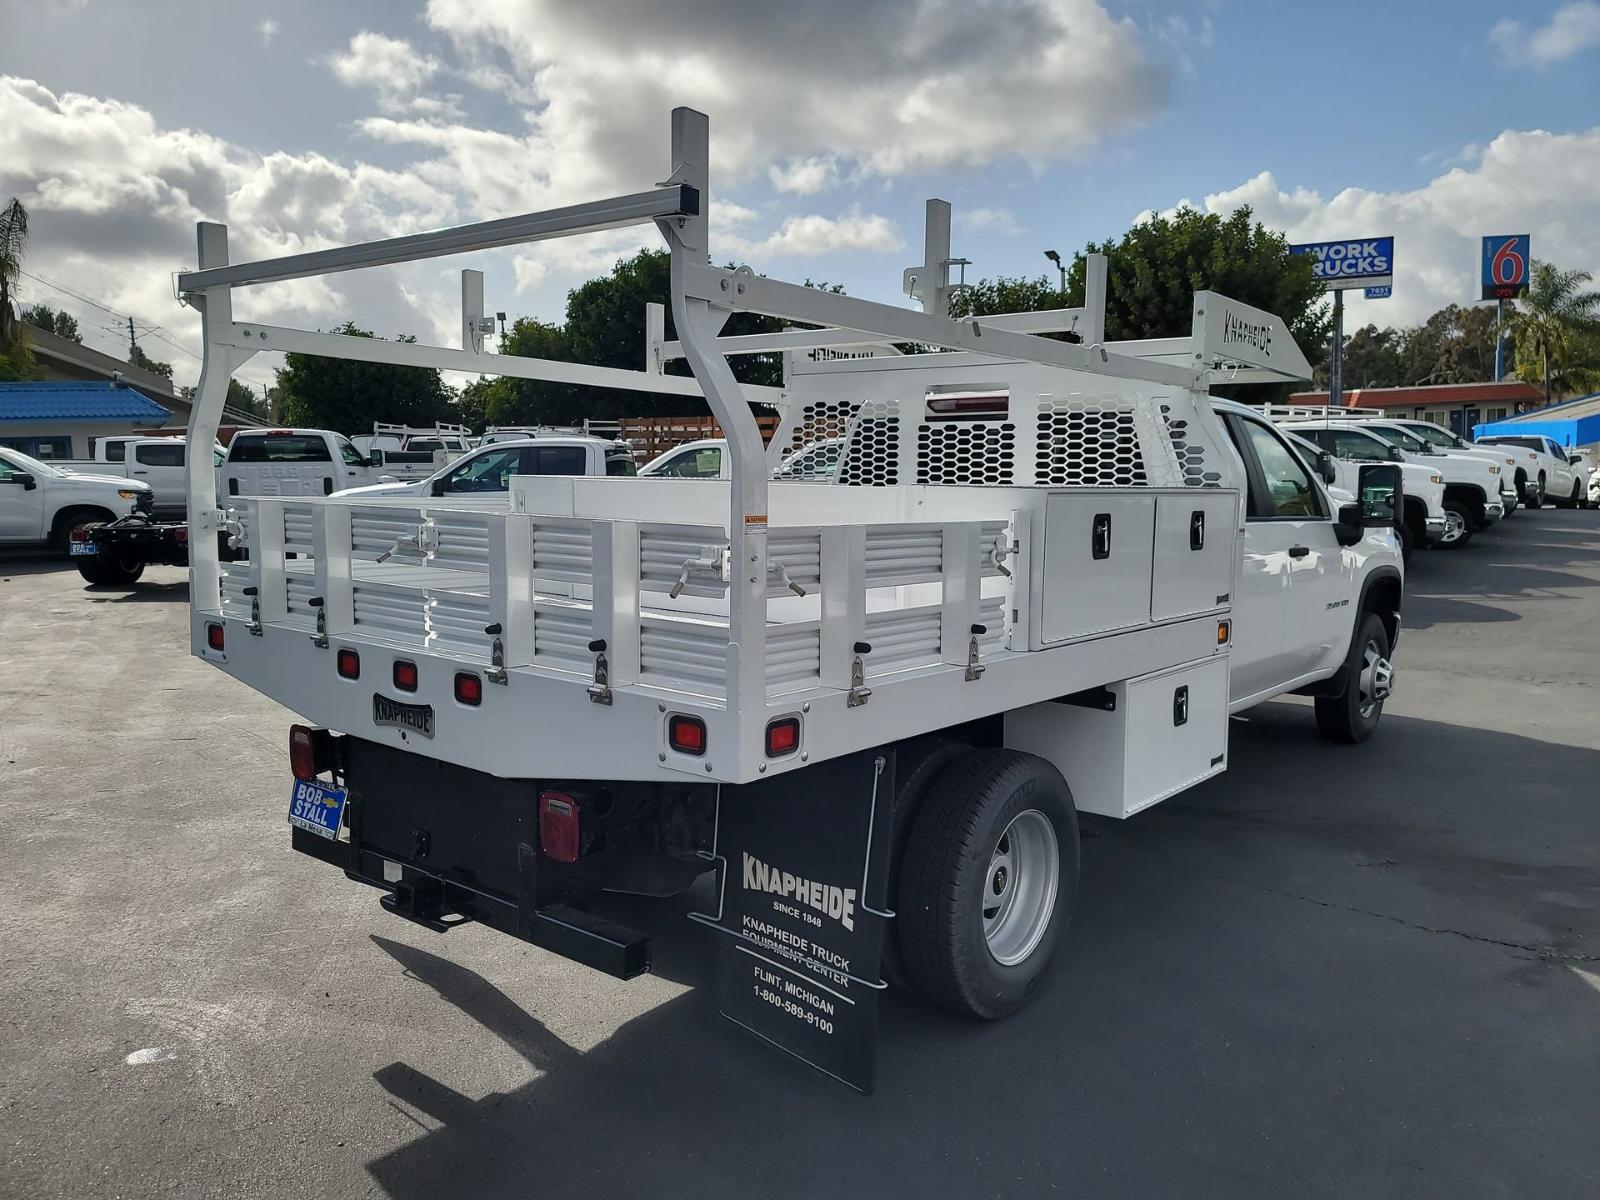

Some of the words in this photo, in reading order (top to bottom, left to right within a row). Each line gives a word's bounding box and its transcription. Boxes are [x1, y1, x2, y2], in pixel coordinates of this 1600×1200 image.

[1304, 242, 1379, 261] WORK
[1312, 256, 1388, 277] RUCKS
[1491, 238, 1524, 285] 6
[1223, 309, 1272, 357] KNAPHEIDE
[374, 697, 432, 733] KNAPHEIDE
[294, 799, 328, 826] STALL
[297, 783, 324, 806] BOB
[742, 851, 857, 932] KNAPHEIDE
[773, 901, 800, 919] SINCE
[802, 912, 822, 928] 1848
[742, 929, 804, 964] EQUIPMENT
[806, 957, 849, 988] CENTER
[743, 914, 809, 952] KNAPHEIDE
[811, 943, 850, 972] TRUCK
[753, 985, 833, 1034] 1-800-589-9100
[754, 966, 782, 991] FLINT,
[784, 981, 834, 1016] MICHIGAN
